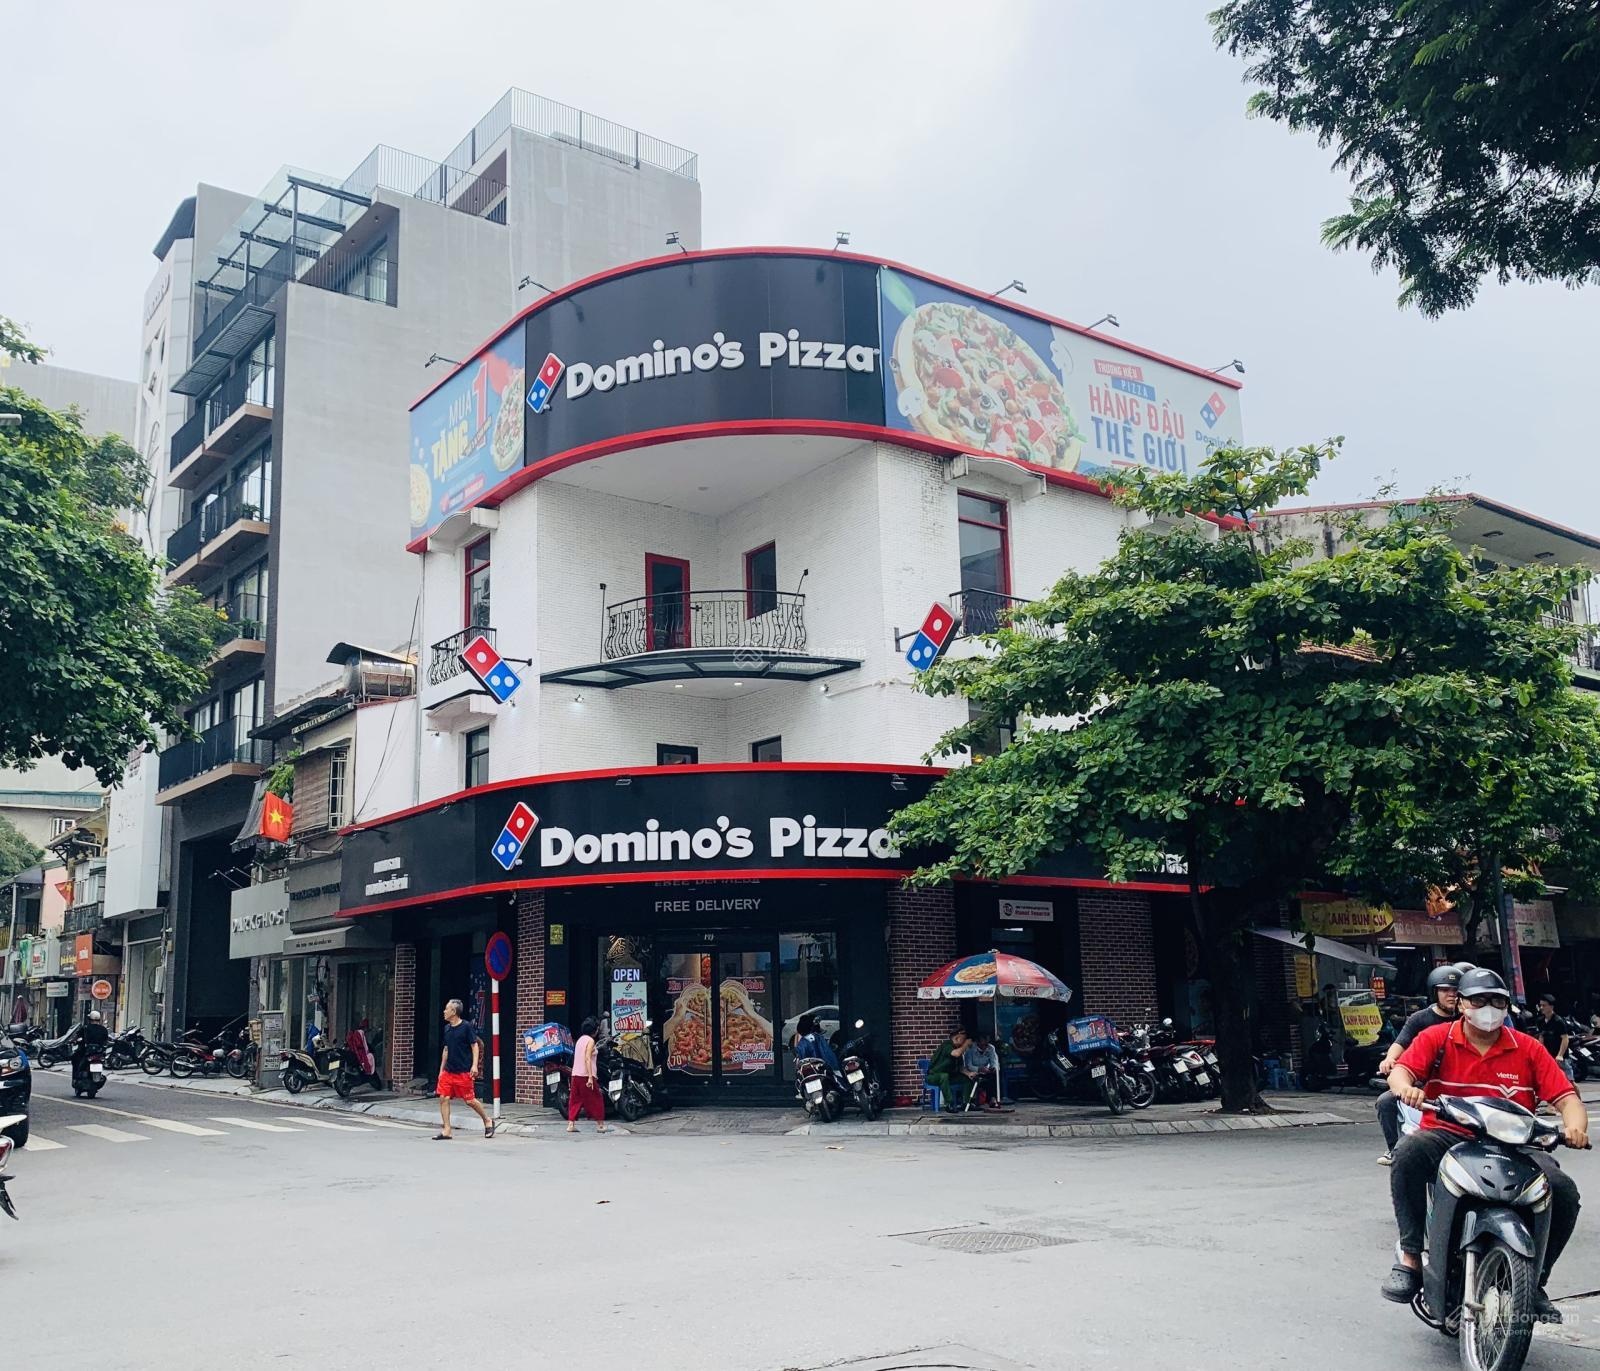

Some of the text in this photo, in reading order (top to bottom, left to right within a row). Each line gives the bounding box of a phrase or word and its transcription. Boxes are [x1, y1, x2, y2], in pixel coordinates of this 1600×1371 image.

[566, 328, 875, 400] Domino's Pizza
[449, 389, 472, 429] MUA
[1120, 380, 1149, 398] PIZZA
[1088, 383, 1185, 440] HÀNG ĐẦU
[1091, 415, 1136, 459] THẾ
[540, 813, 901, 868] Domino's Pizza
[654, 898, 761, 912] FREE DELIVERY
[613, 968, 640, 982] OPEN
